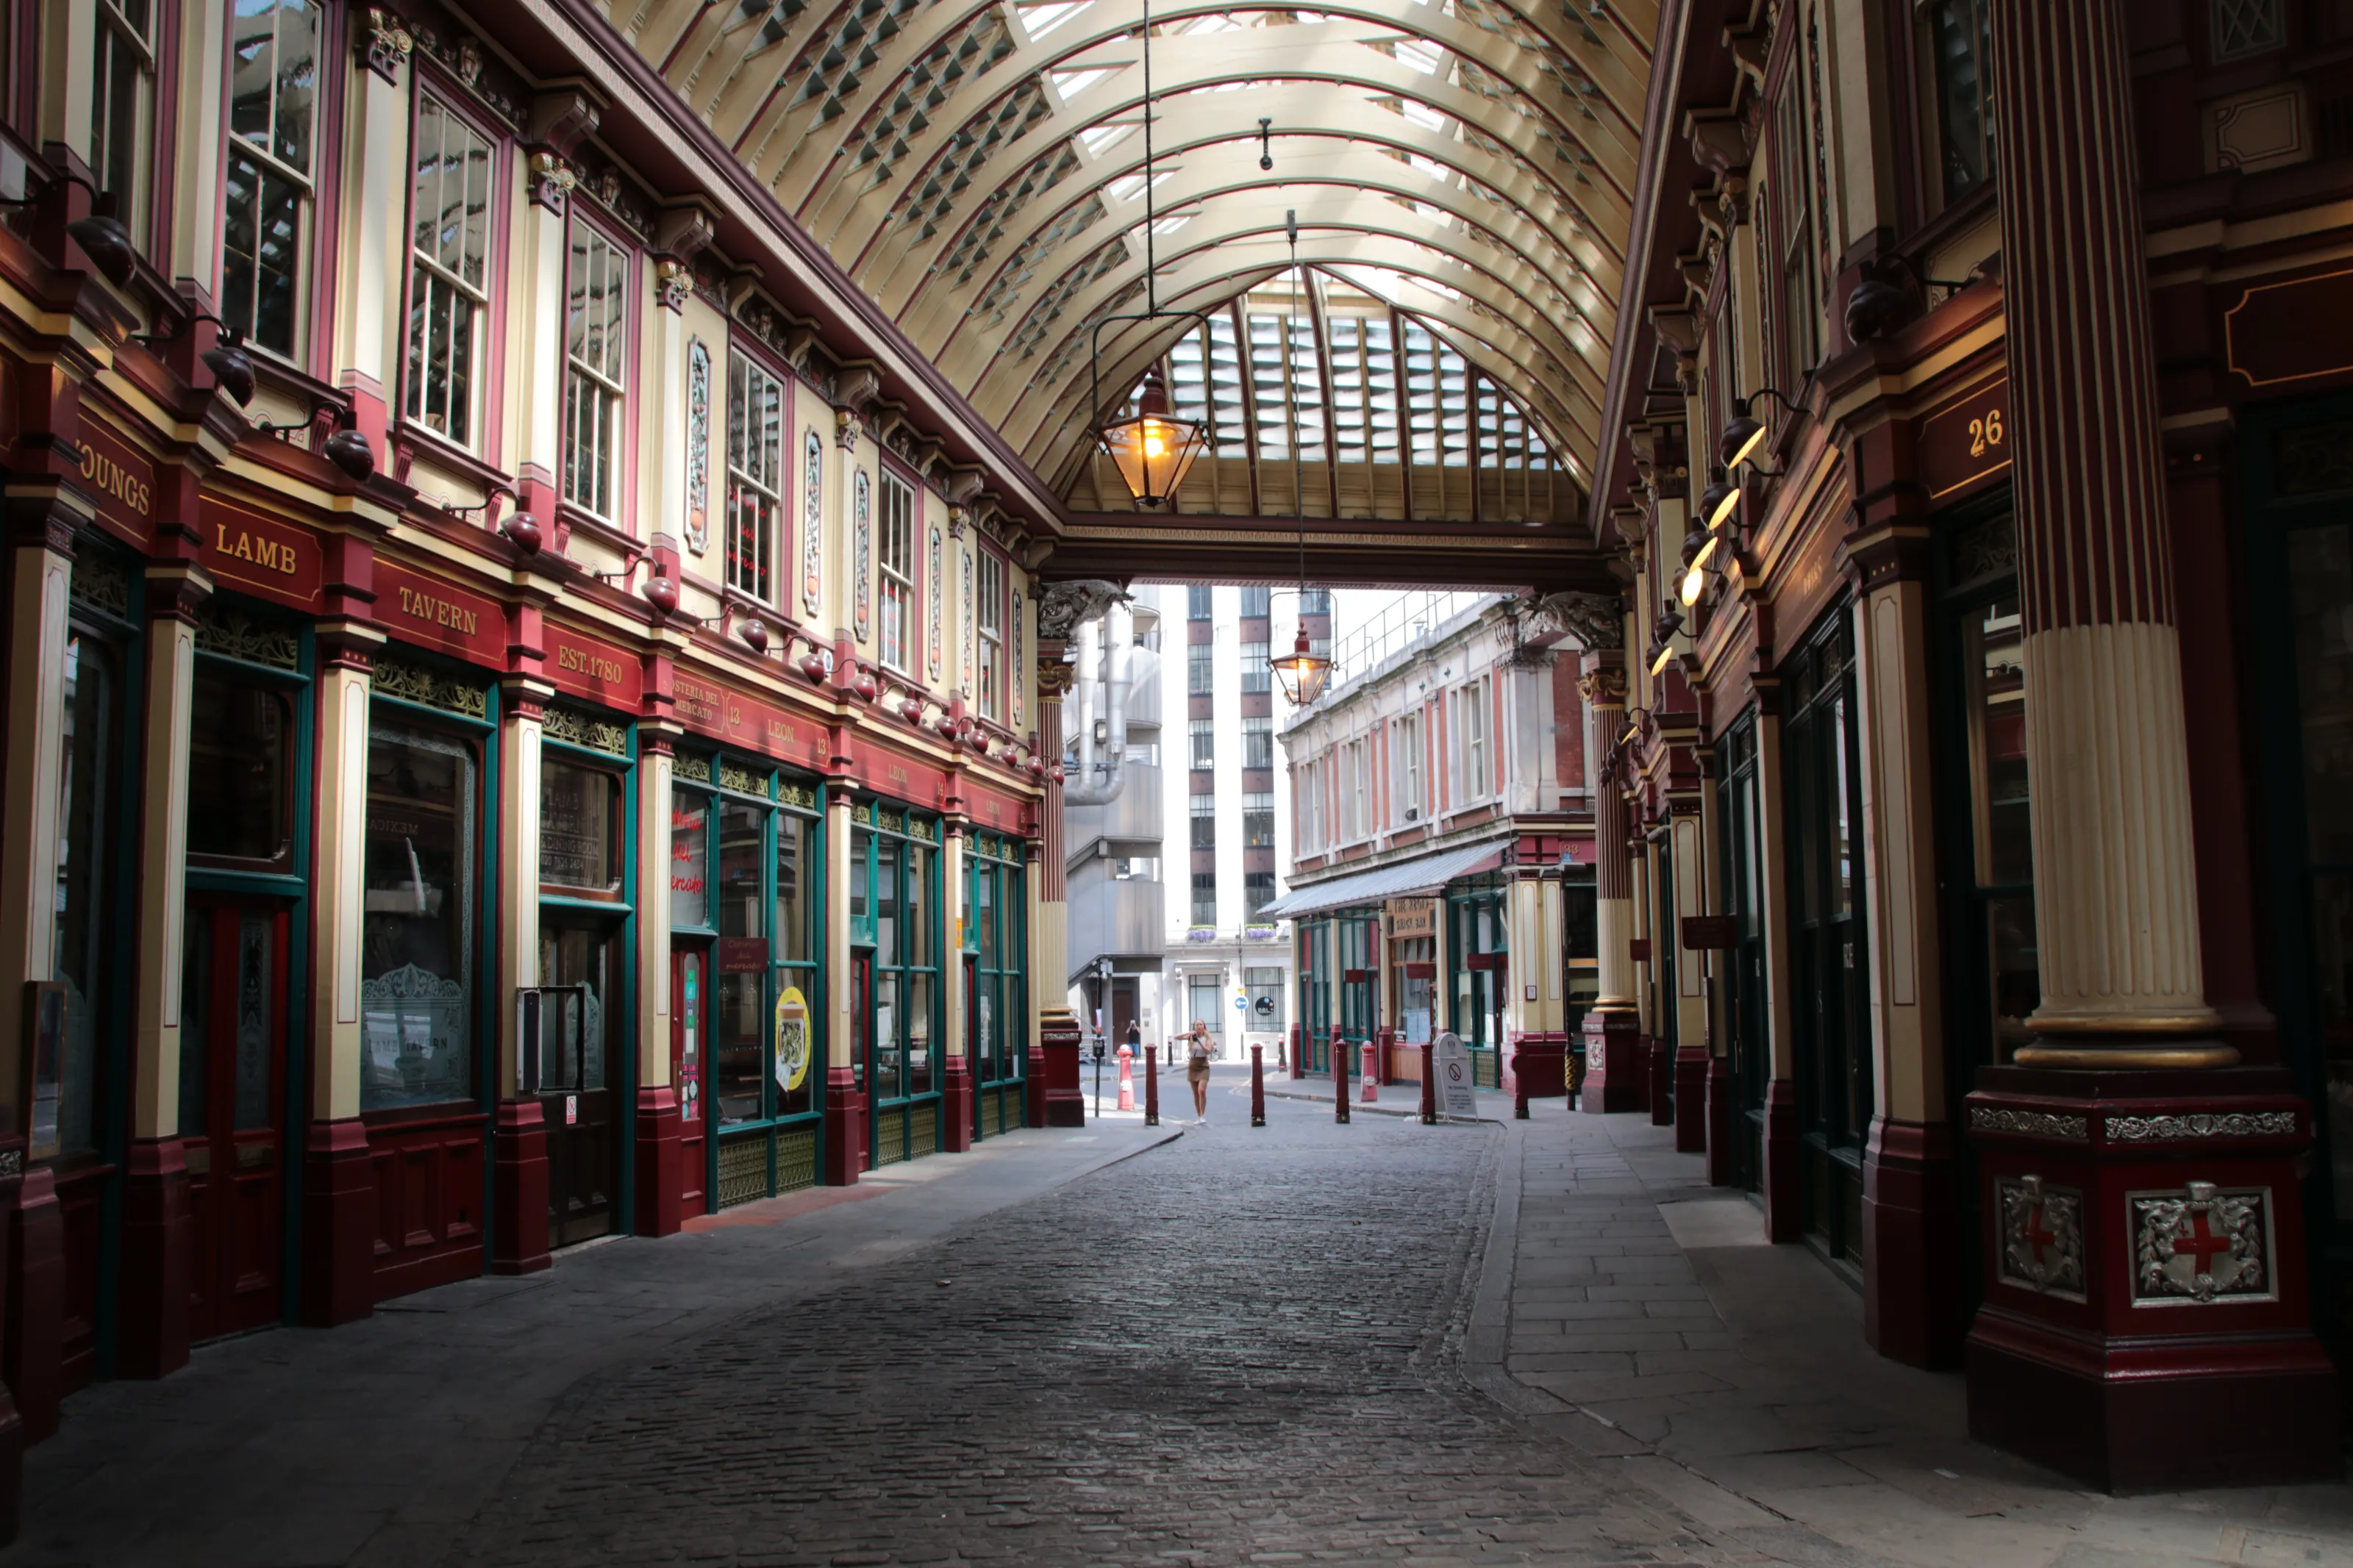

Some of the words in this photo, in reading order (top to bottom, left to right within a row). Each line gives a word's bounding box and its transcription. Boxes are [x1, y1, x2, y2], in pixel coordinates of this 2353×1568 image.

[1968, 409, 2002, 457] 26
[76, 439, 149, 516] OUNGS
[215, 523, 296, 576] LAMB
[399, 586, 477, 636] TAVERN
[704, 691, 720, 706] DEL
[675, 699, 713, 721] MERCATO
[730, 706, 740, 726] 13
[768, 719, 794, 743] LEON
[817, 737, 826, 755] 13
[888, 764, 907, 783] LEON
[937, 781, 943, 797] 14
[986, 798, 1000, 815] LEON
[672, 840, 693, 863] del
